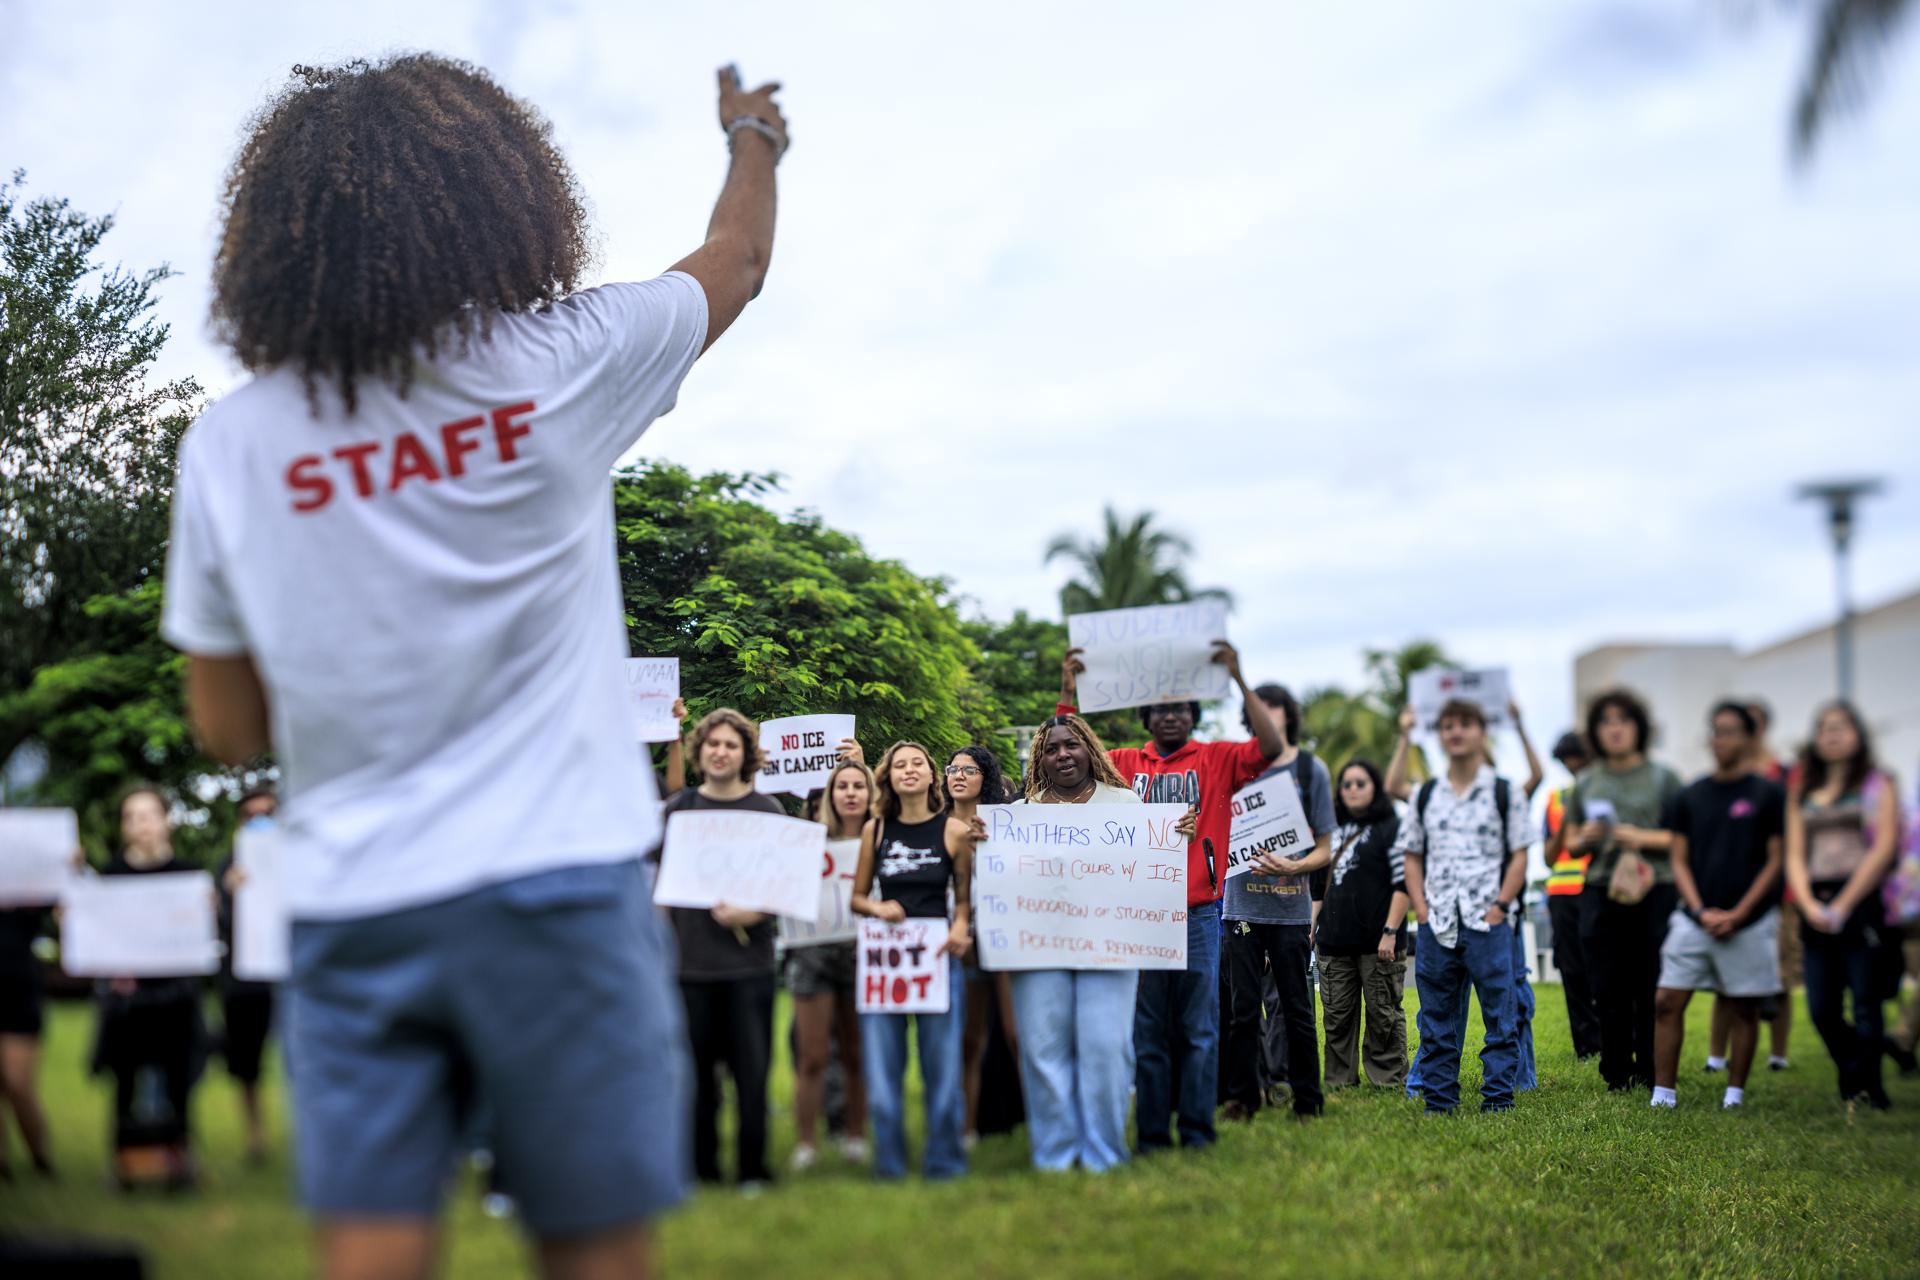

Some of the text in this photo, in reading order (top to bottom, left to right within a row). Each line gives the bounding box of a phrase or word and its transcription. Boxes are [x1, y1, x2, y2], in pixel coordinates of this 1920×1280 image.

[284, 400, 538, 515] STAFF
[781, 731, 825, 751] NO ICE
[1147, 769, 1201, 811] NBA
[1231, 791, 1266, 817] O ICE
[990, 808, 1184, 849] PANTHERS SAY NO
[1240, 828, 1300, 862] CAMPUS!
[1018, 855, 1064, 879] FIU
[1071, 859, 1115, 880] COLLAB
[1147, 864, 1184, 883] ICE
[1016, 895, 1089, 919] REVOCATION
[1114, 906, 1168, 922] STUDENT
[1018, 929, 1095, 952] POLITICAL
[867, 946, 927, 968] NOT
[866, 974, 933, 1004] HOT
